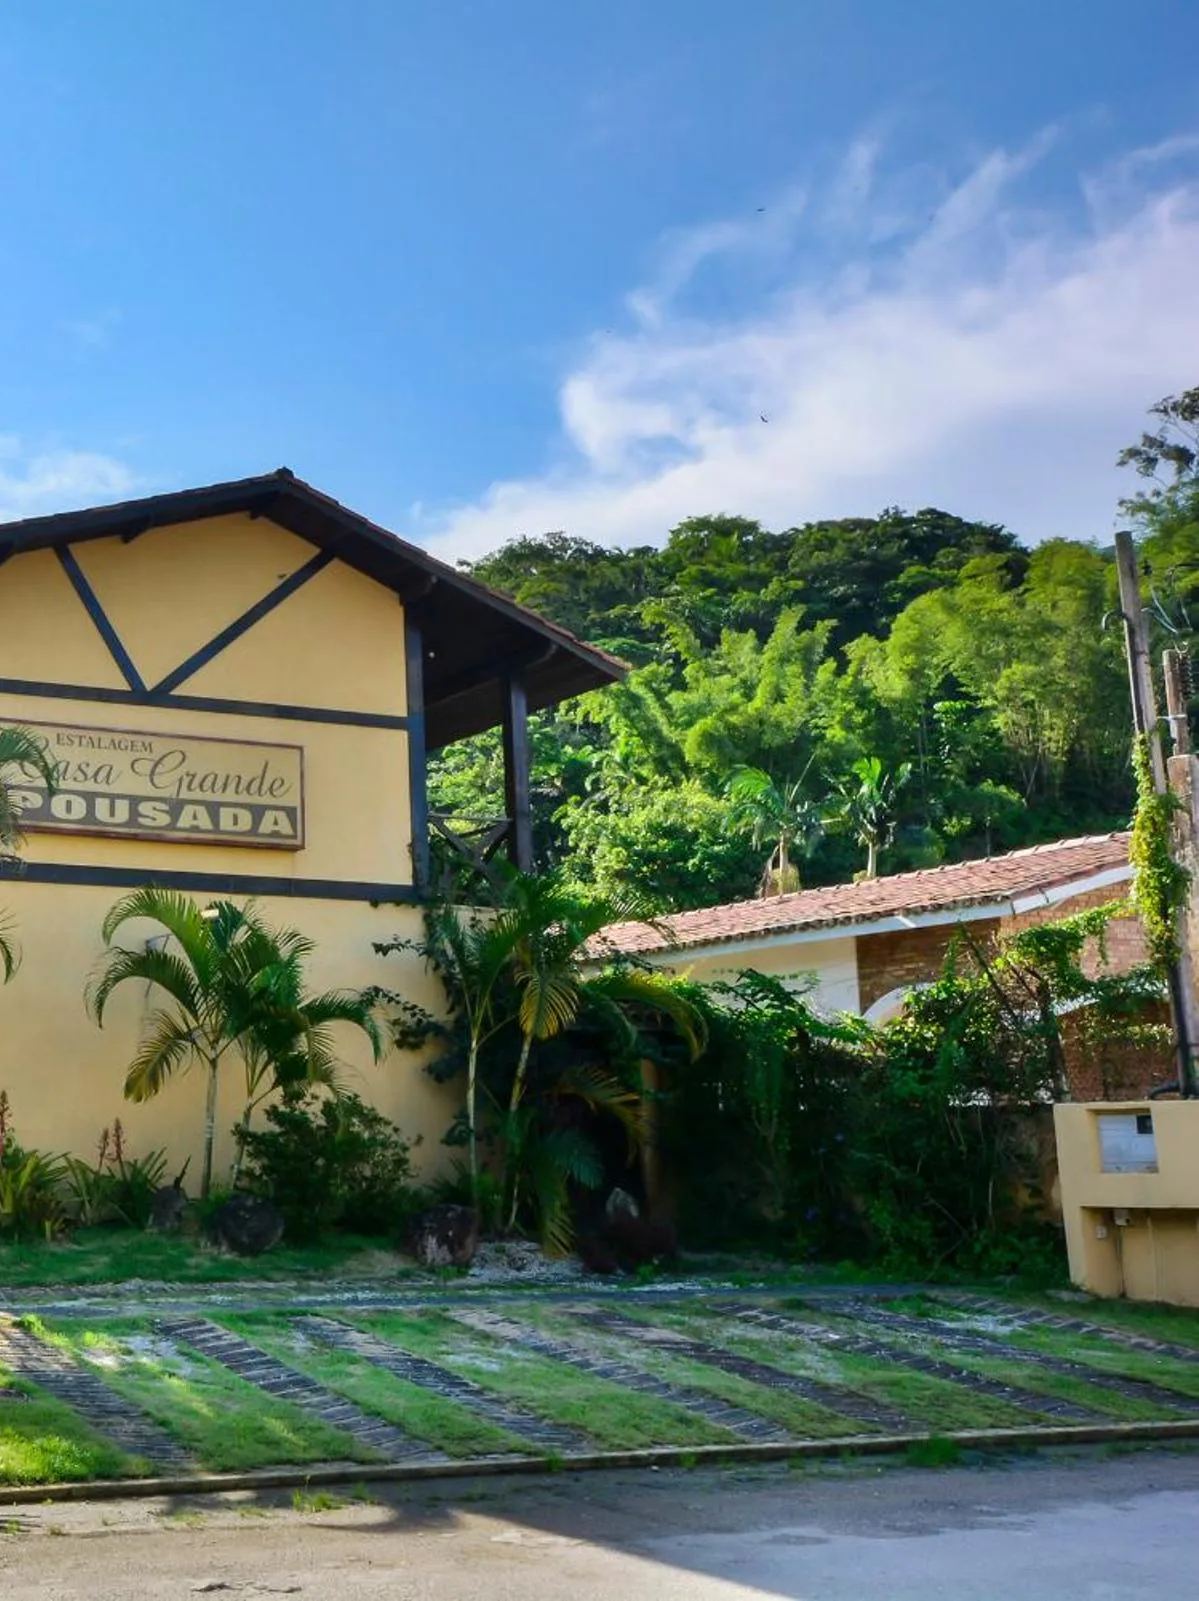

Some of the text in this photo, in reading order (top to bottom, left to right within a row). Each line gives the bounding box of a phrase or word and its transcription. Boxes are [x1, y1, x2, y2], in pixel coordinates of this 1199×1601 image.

[56, 732, 154, 754] ESTALAGEM
[130, 749, 293, 799] Grande
[5, 788, 295, 837] POUSADA
